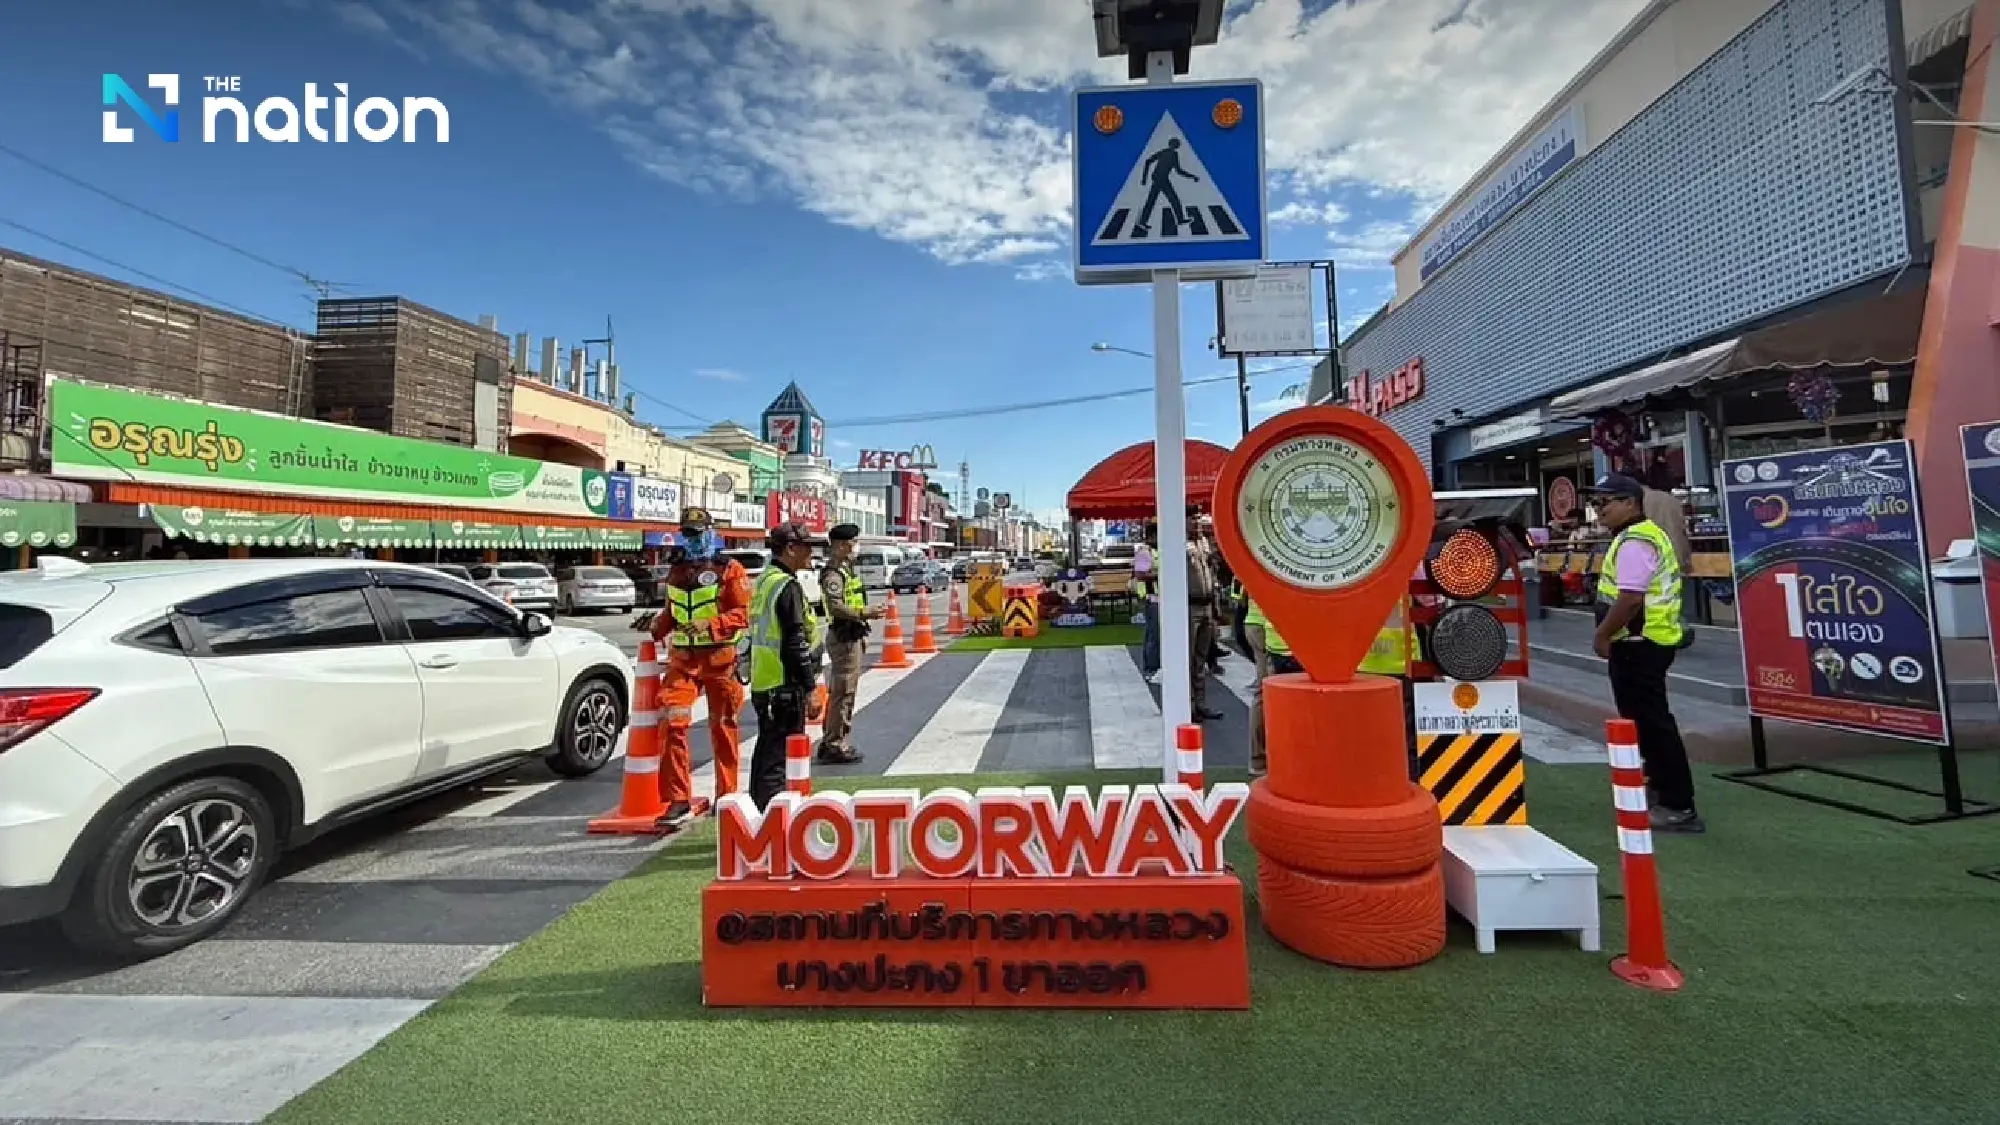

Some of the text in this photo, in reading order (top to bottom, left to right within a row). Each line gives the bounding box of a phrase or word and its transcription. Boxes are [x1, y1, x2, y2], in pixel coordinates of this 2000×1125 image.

[89, 416, 245, 472] อรุณรุ่ง
[268, 443, 358, 472] ลูกชิ้นน้ำใส
[1258, 542, 1386, 583] DEPARTMENT OF HIGHWAYS
[1774, 573, 1804, 638] 1
[1799, 573, 1884, 617] ใส่ใจ
[1806, 620, 1884, 644] ตนเอง
[717, 784, 1249, 880] MOTORWAY
[972, 956, 991, 993] 1
[1002, 957, 1148, 994] ขาออก
